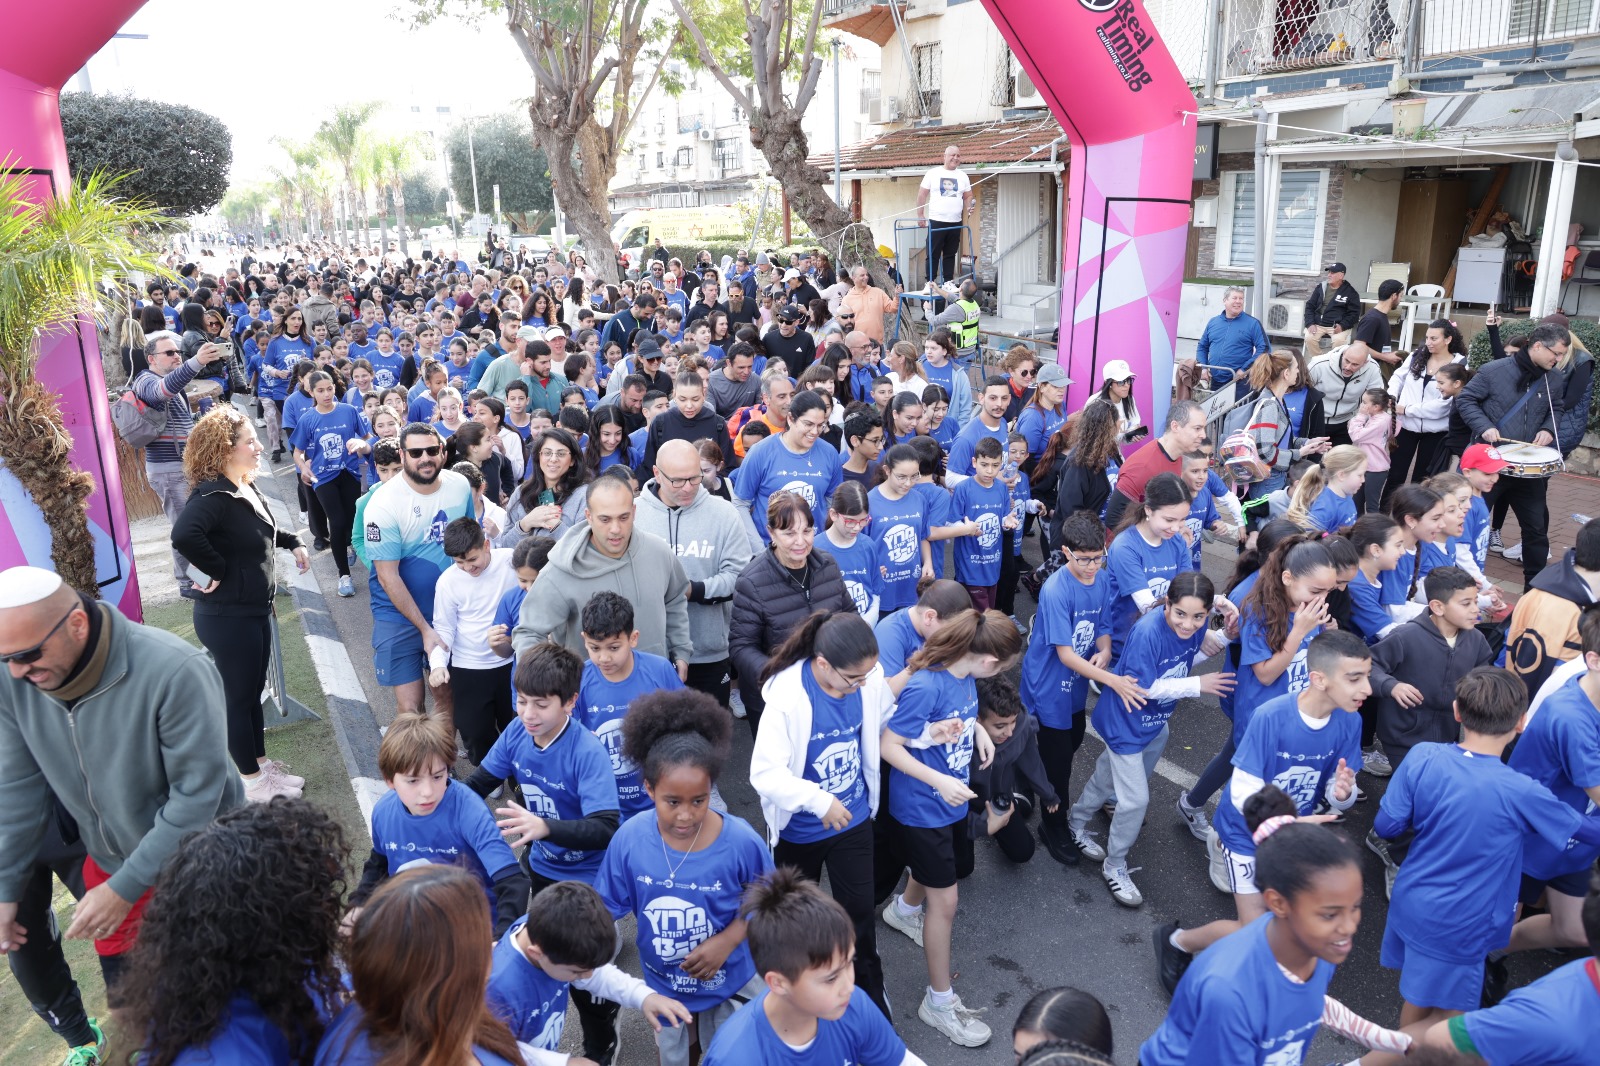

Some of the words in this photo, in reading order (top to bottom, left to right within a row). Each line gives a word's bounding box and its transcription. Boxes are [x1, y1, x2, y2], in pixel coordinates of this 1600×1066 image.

[1118, 0, 1154, 51] Real
[1096, 28, 1132, 80] realtiming.co.il
[1102, 9, 1153, 92] Timing
[669, 539, 715, 559] eAir
[643, 907, 707, 935] מרוץ
[690, 925, 707, 935] אור
[661, 930, 687, 938] יהודה
[675, 975, 698, 986] מקצ
